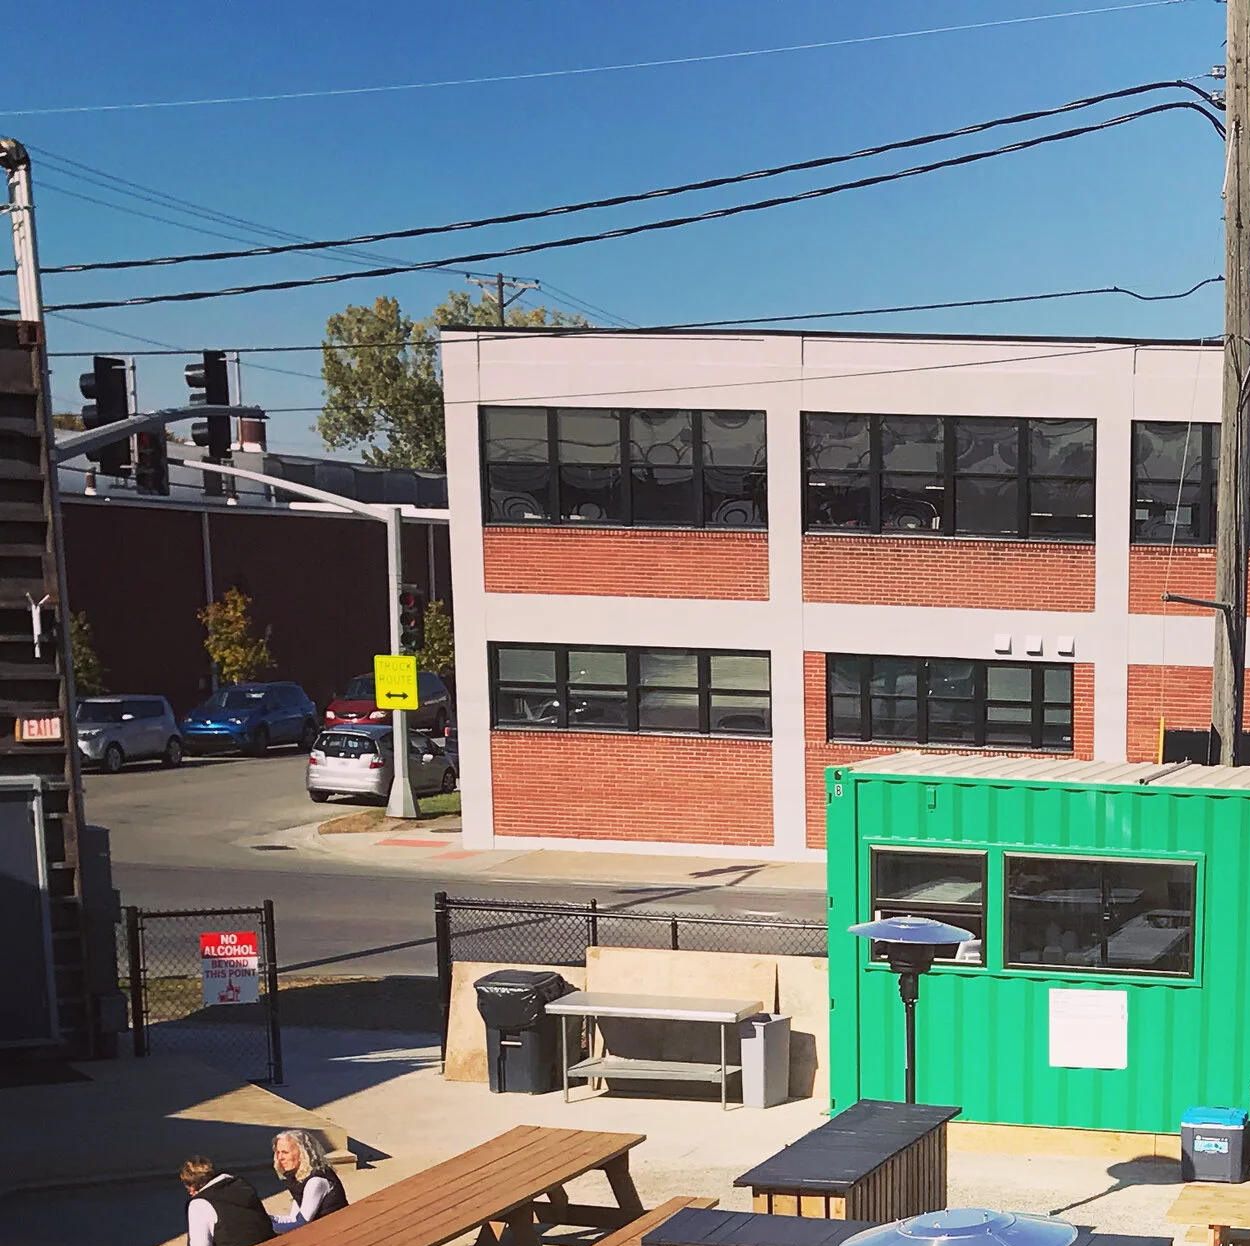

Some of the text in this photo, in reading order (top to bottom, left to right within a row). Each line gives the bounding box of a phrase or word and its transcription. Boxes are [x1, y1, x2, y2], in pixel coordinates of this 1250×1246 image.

[378, 660, 412, 672] TRUCK
[379, 674, 413, 685] ROUTE
[27, 718, 54, 737] EXIT
[220, 934, 238, 945] NO
[204, 944, 257, 957] ALCOHOL
[211, 959, 249, 969] BEYOND
[204, 967, 256, 979] THIS POINT
